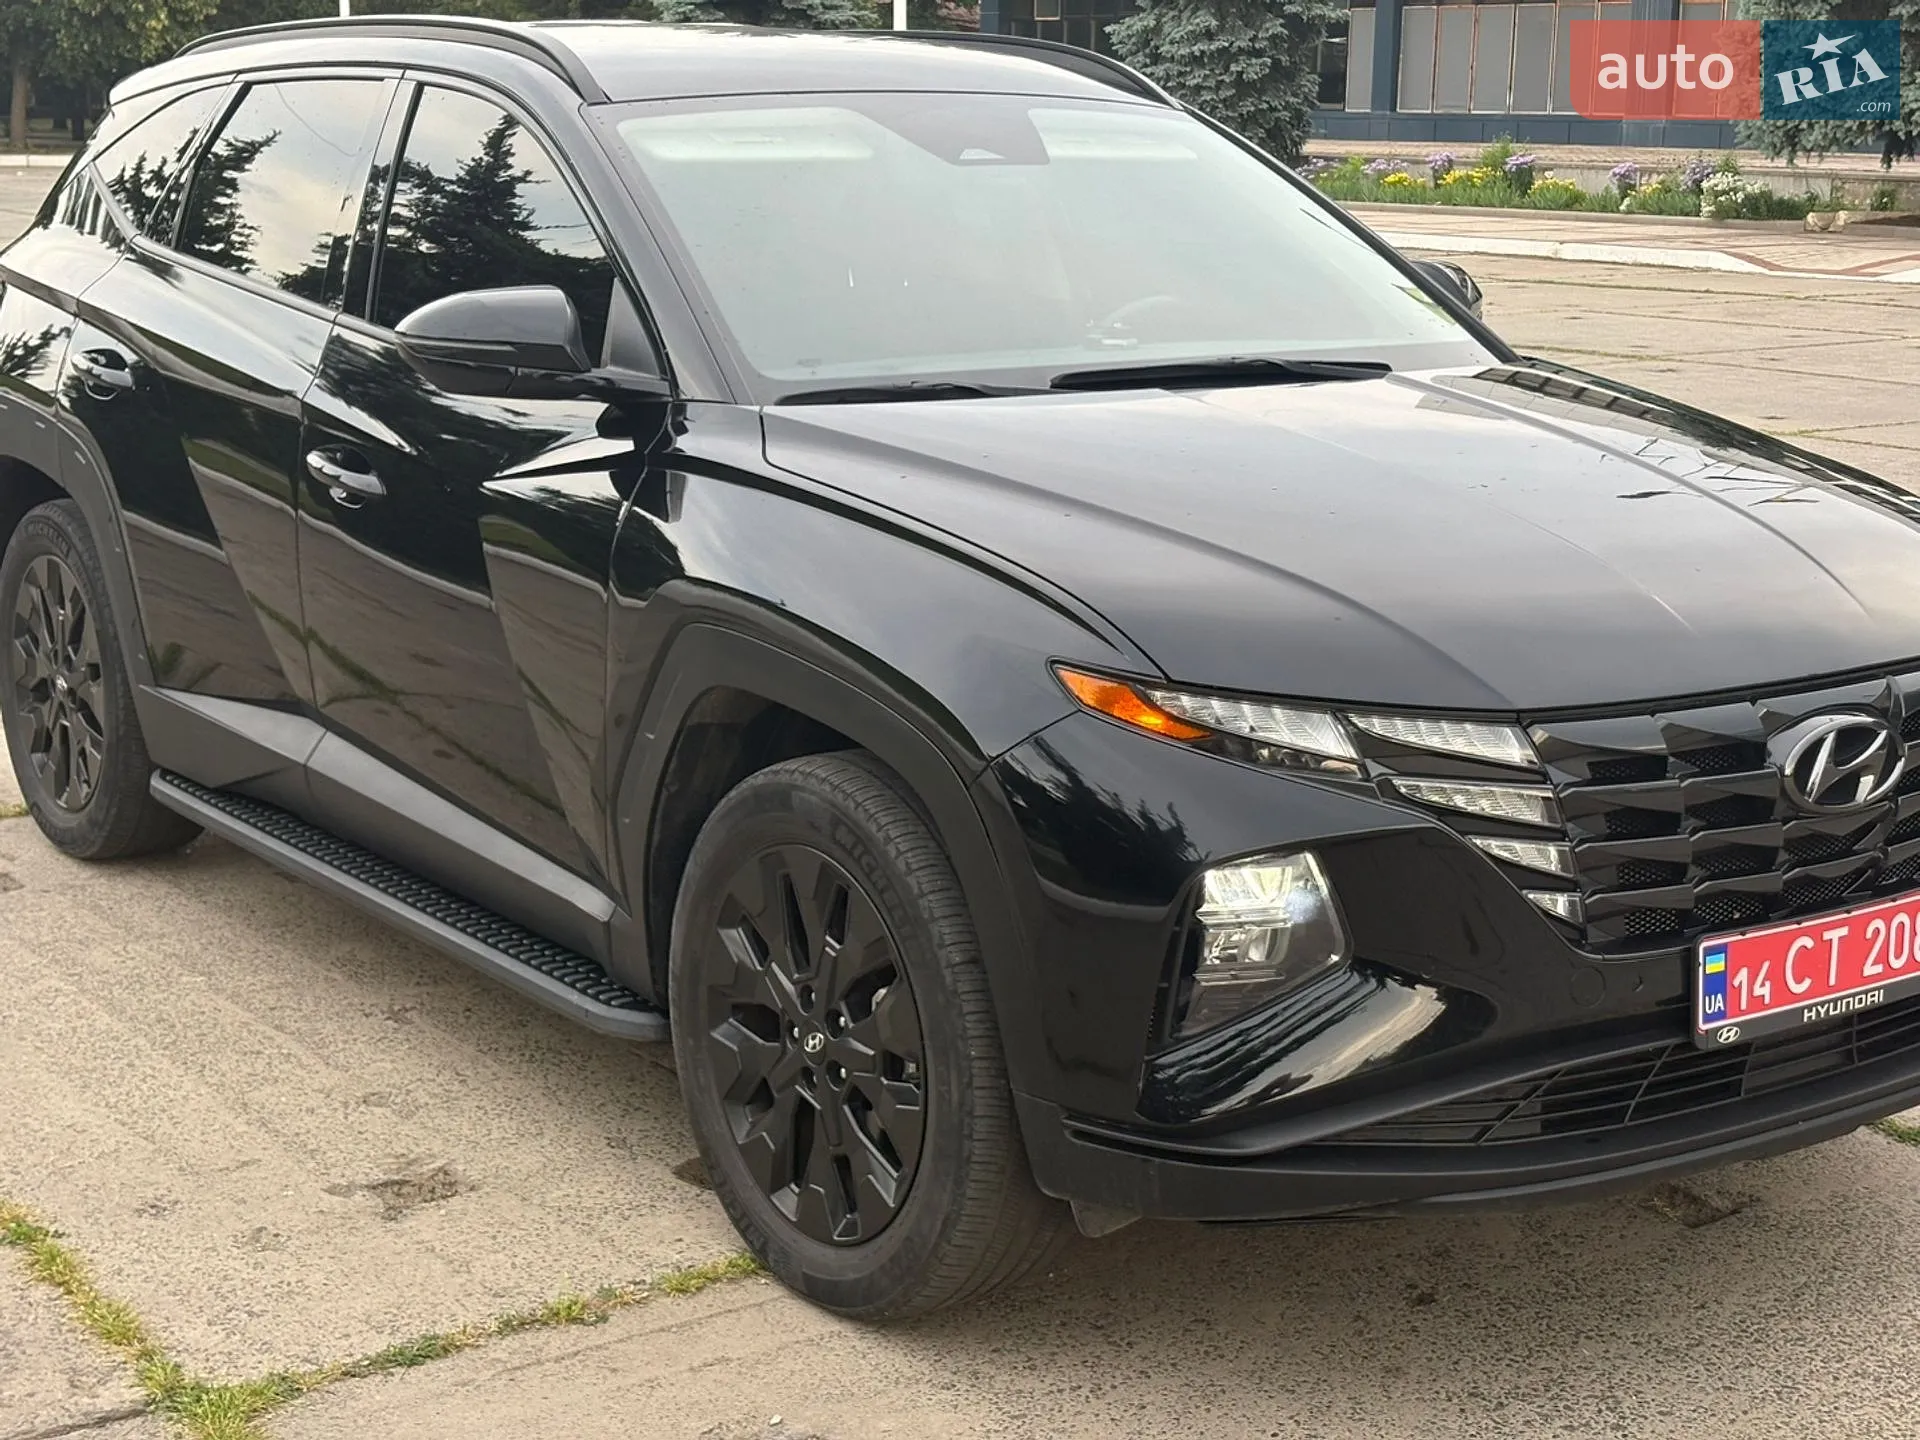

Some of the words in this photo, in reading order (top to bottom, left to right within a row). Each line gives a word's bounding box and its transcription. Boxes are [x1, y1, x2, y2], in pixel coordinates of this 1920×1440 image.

[1732, 960, 1771, 1011] 14
[1785, 925, 1849, 995] CT
[1705, 993, 1725, 1014] UA
[1803, 989, 1884, 1022] HYUNDAI
